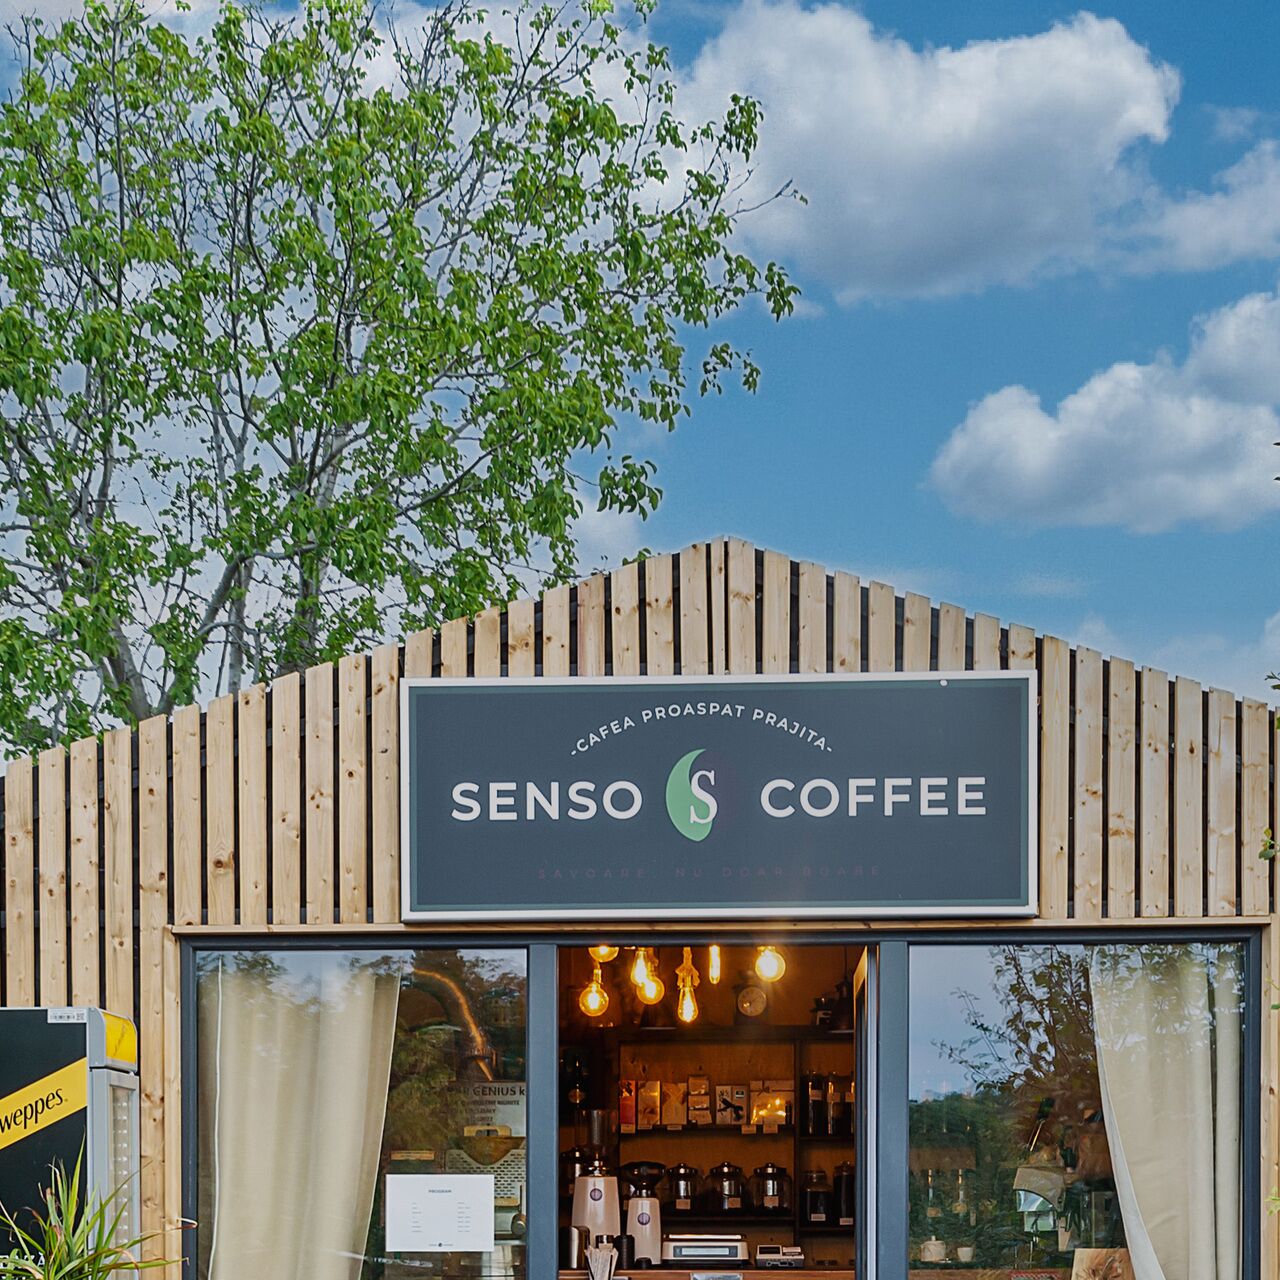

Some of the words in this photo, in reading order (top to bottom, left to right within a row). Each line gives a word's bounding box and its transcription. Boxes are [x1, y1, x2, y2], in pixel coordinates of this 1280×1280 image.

[641, 702, 746, 724] PROASPAT
[451, 780, 643, 821] SENSO
[689, 770, 718, 824] S
[760, 776, 987, 818] COFFEE
[472, 1085, 517, 1096] GENIUS
